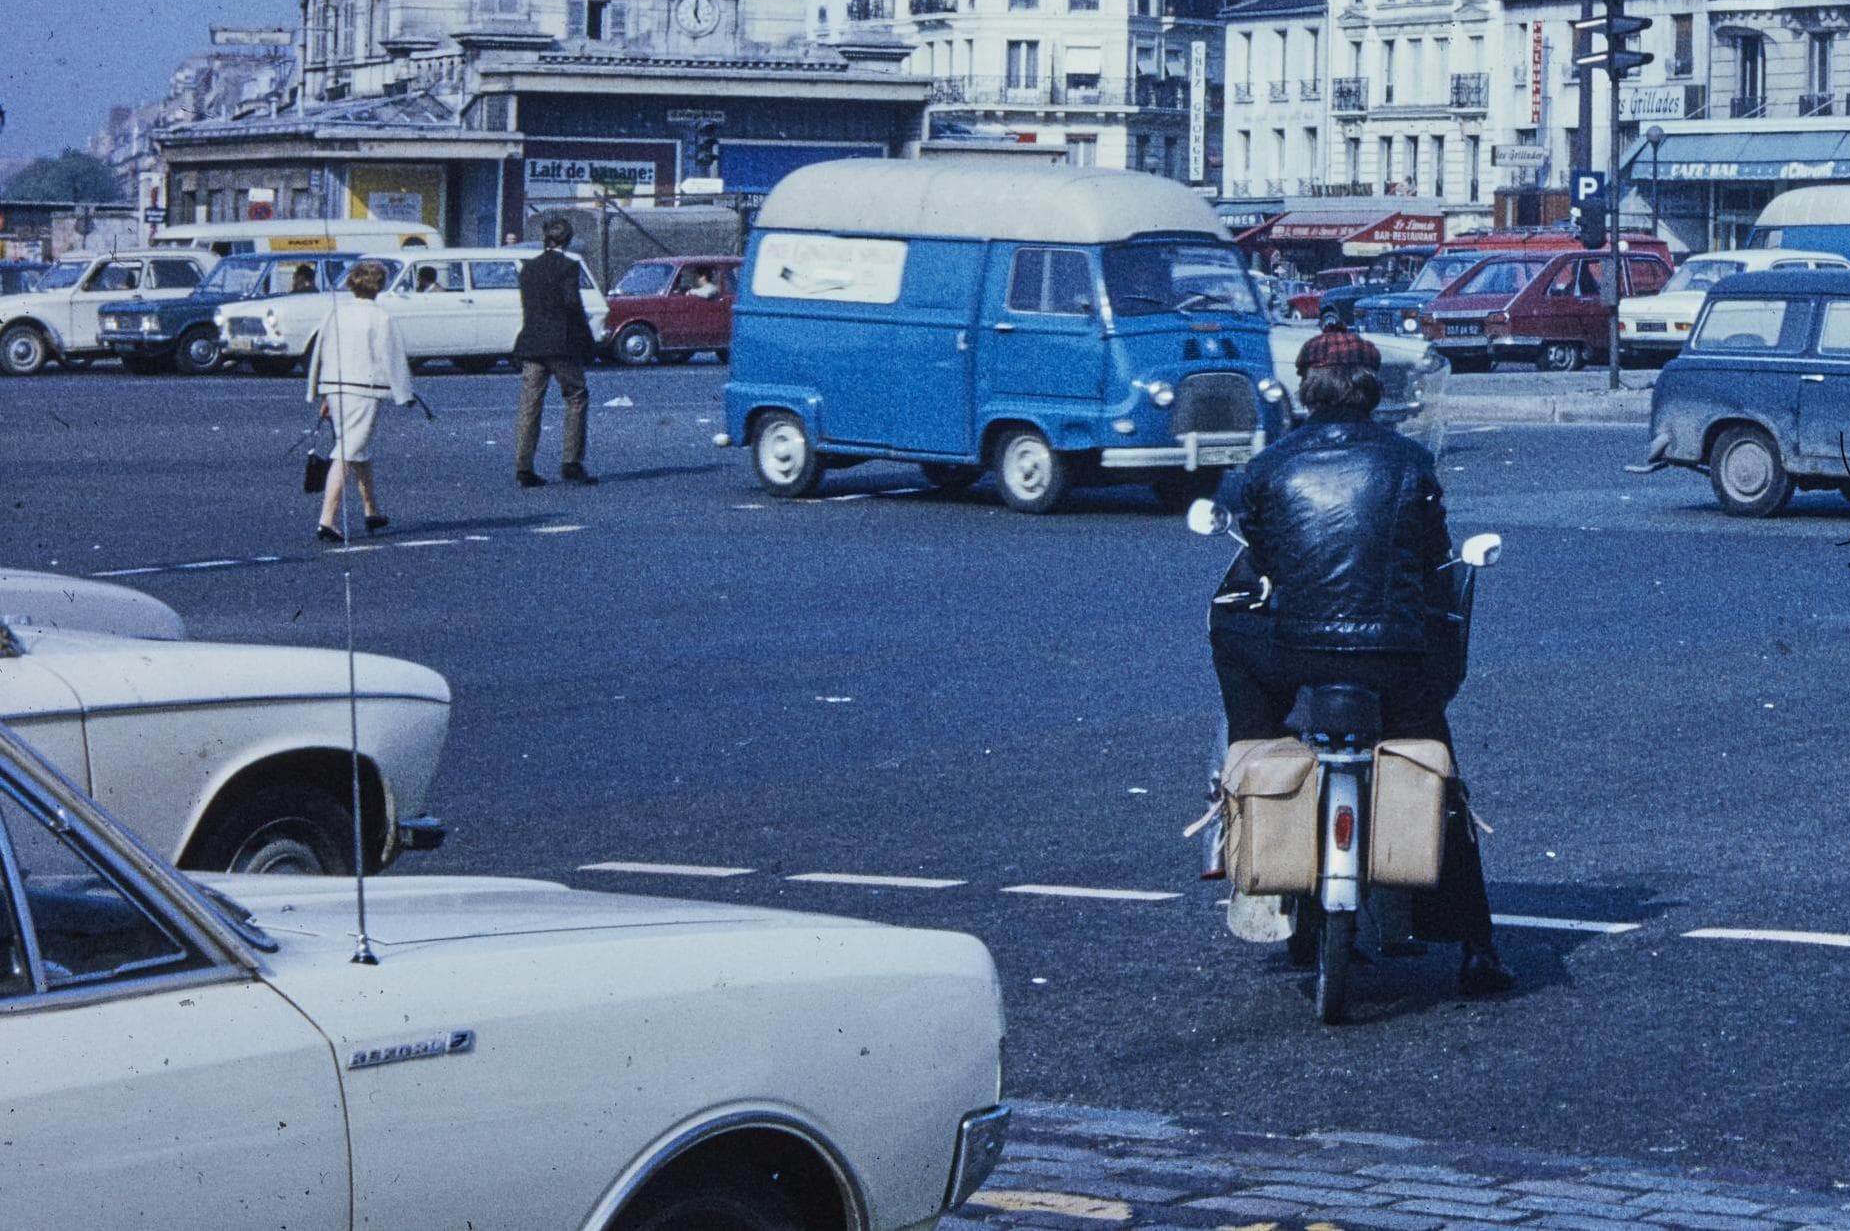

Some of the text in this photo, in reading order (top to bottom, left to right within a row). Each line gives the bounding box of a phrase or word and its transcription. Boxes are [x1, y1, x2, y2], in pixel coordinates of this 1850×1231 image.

[1630, 87, 1680, 118] Grillades
[529, 161, 562, 179] Lait
[566, 162, 585, 179] de
[1578, 176, 1598, 200] P
